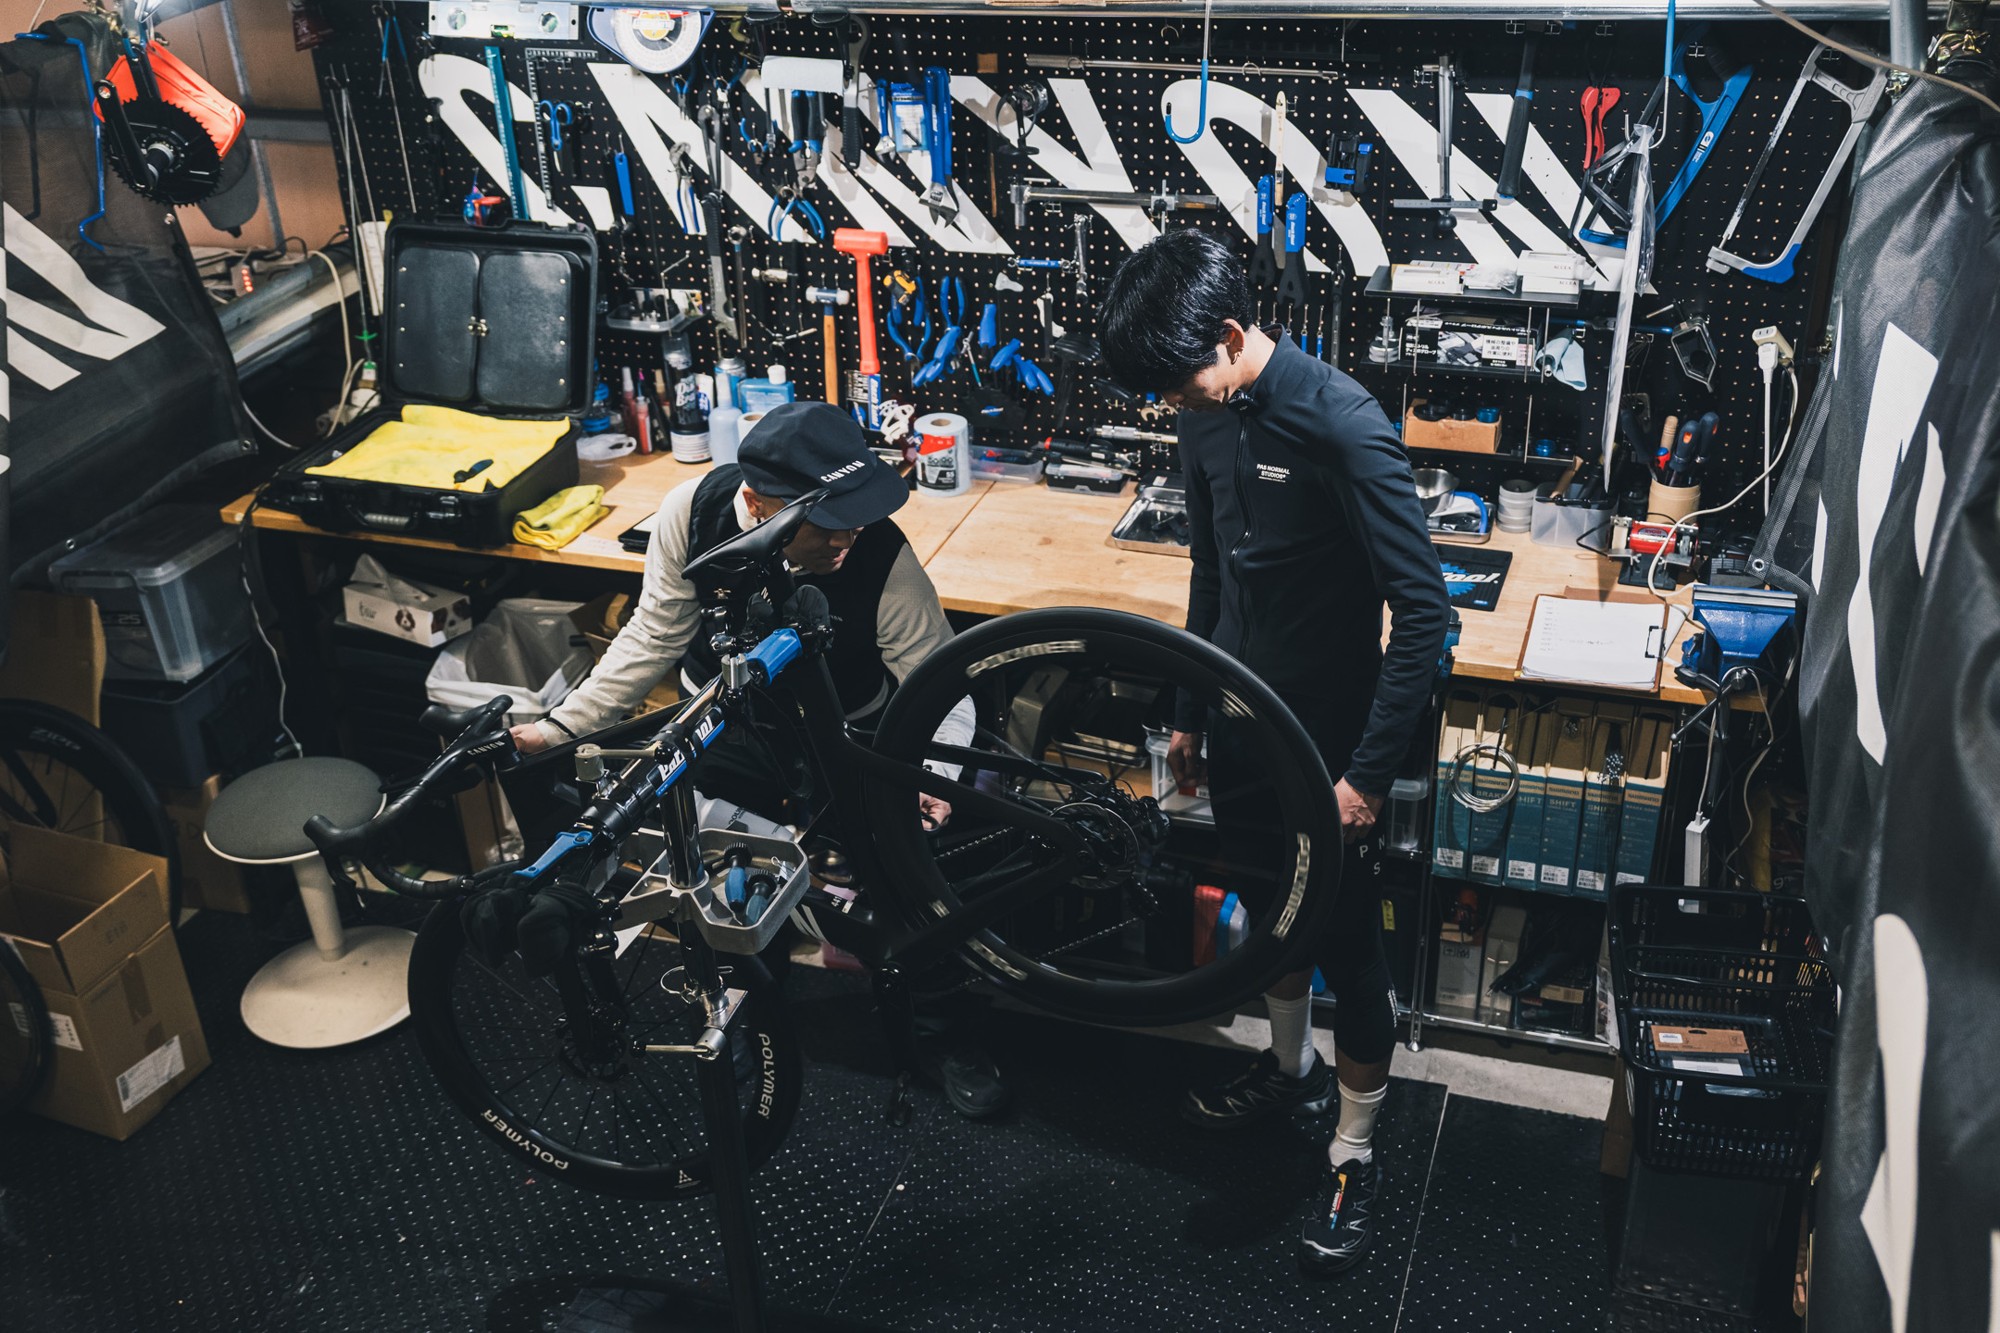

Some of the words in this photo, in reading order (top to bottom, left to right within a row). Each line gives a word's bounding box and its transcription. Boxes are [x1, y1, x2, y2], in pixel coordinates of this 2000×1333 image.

[418, 54, 1659, 295] CANYON
[820, 460, 866, 483] CANYON
[466, 740, 506, 756] CANYON
[1549, 798, 1577, 808] SHIFT
[1358, 844, 1369, 859] P
[1373, 861, 1381, 876] S
[758, 1033, 775, 1117] POLYMER
[481, 1108, 569, 1171] POLYMER
